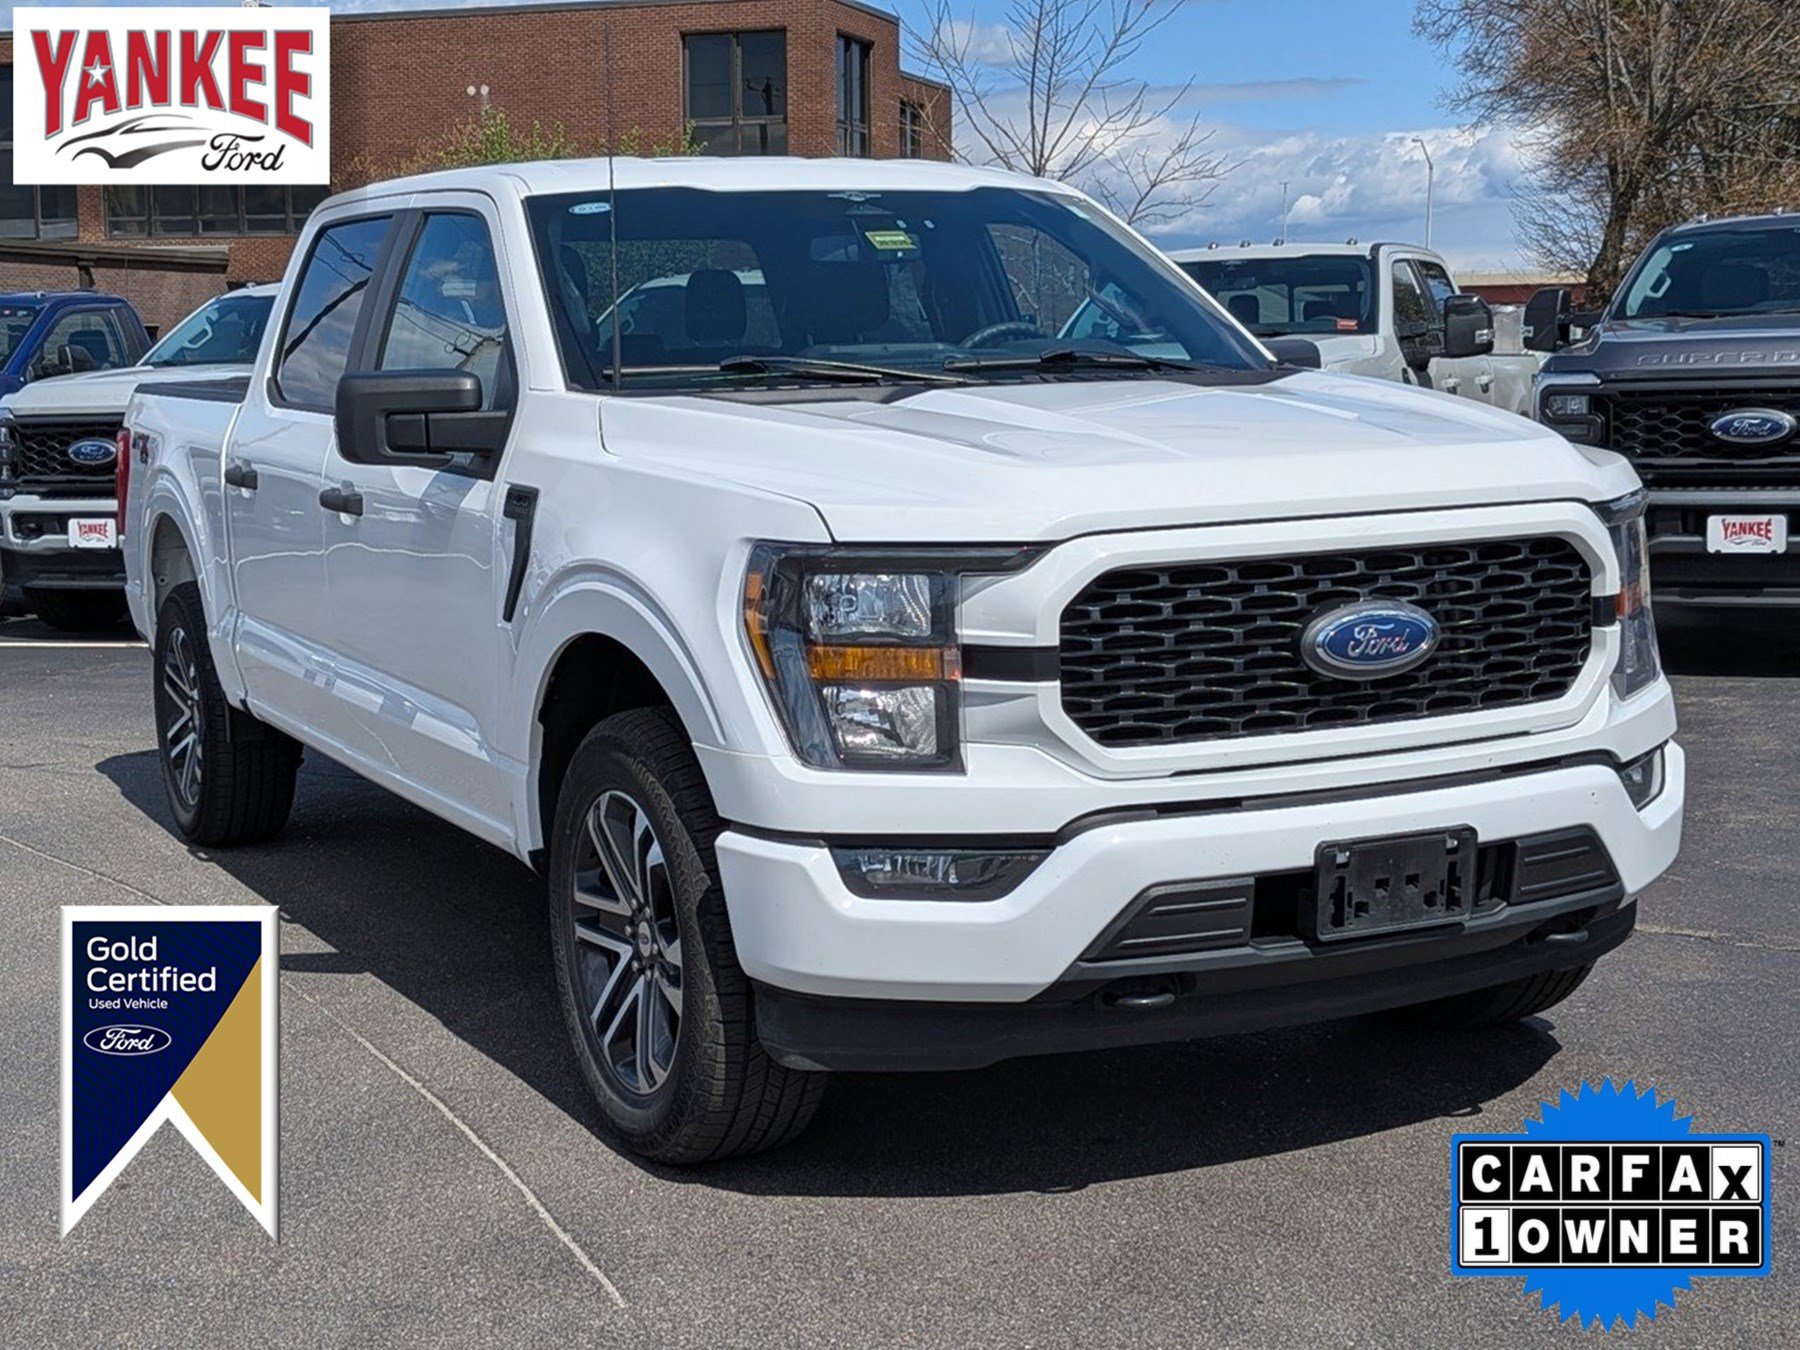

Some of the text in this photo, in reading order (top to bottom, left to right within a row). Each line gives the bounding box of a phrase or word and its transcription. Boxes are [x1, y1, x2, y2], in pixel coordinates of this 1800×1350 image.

[1730, 418, 1772, 436] Ford
[1721, 518, 1772, 541] YANKEE
[1347, 623, 1410, 657] Ford
